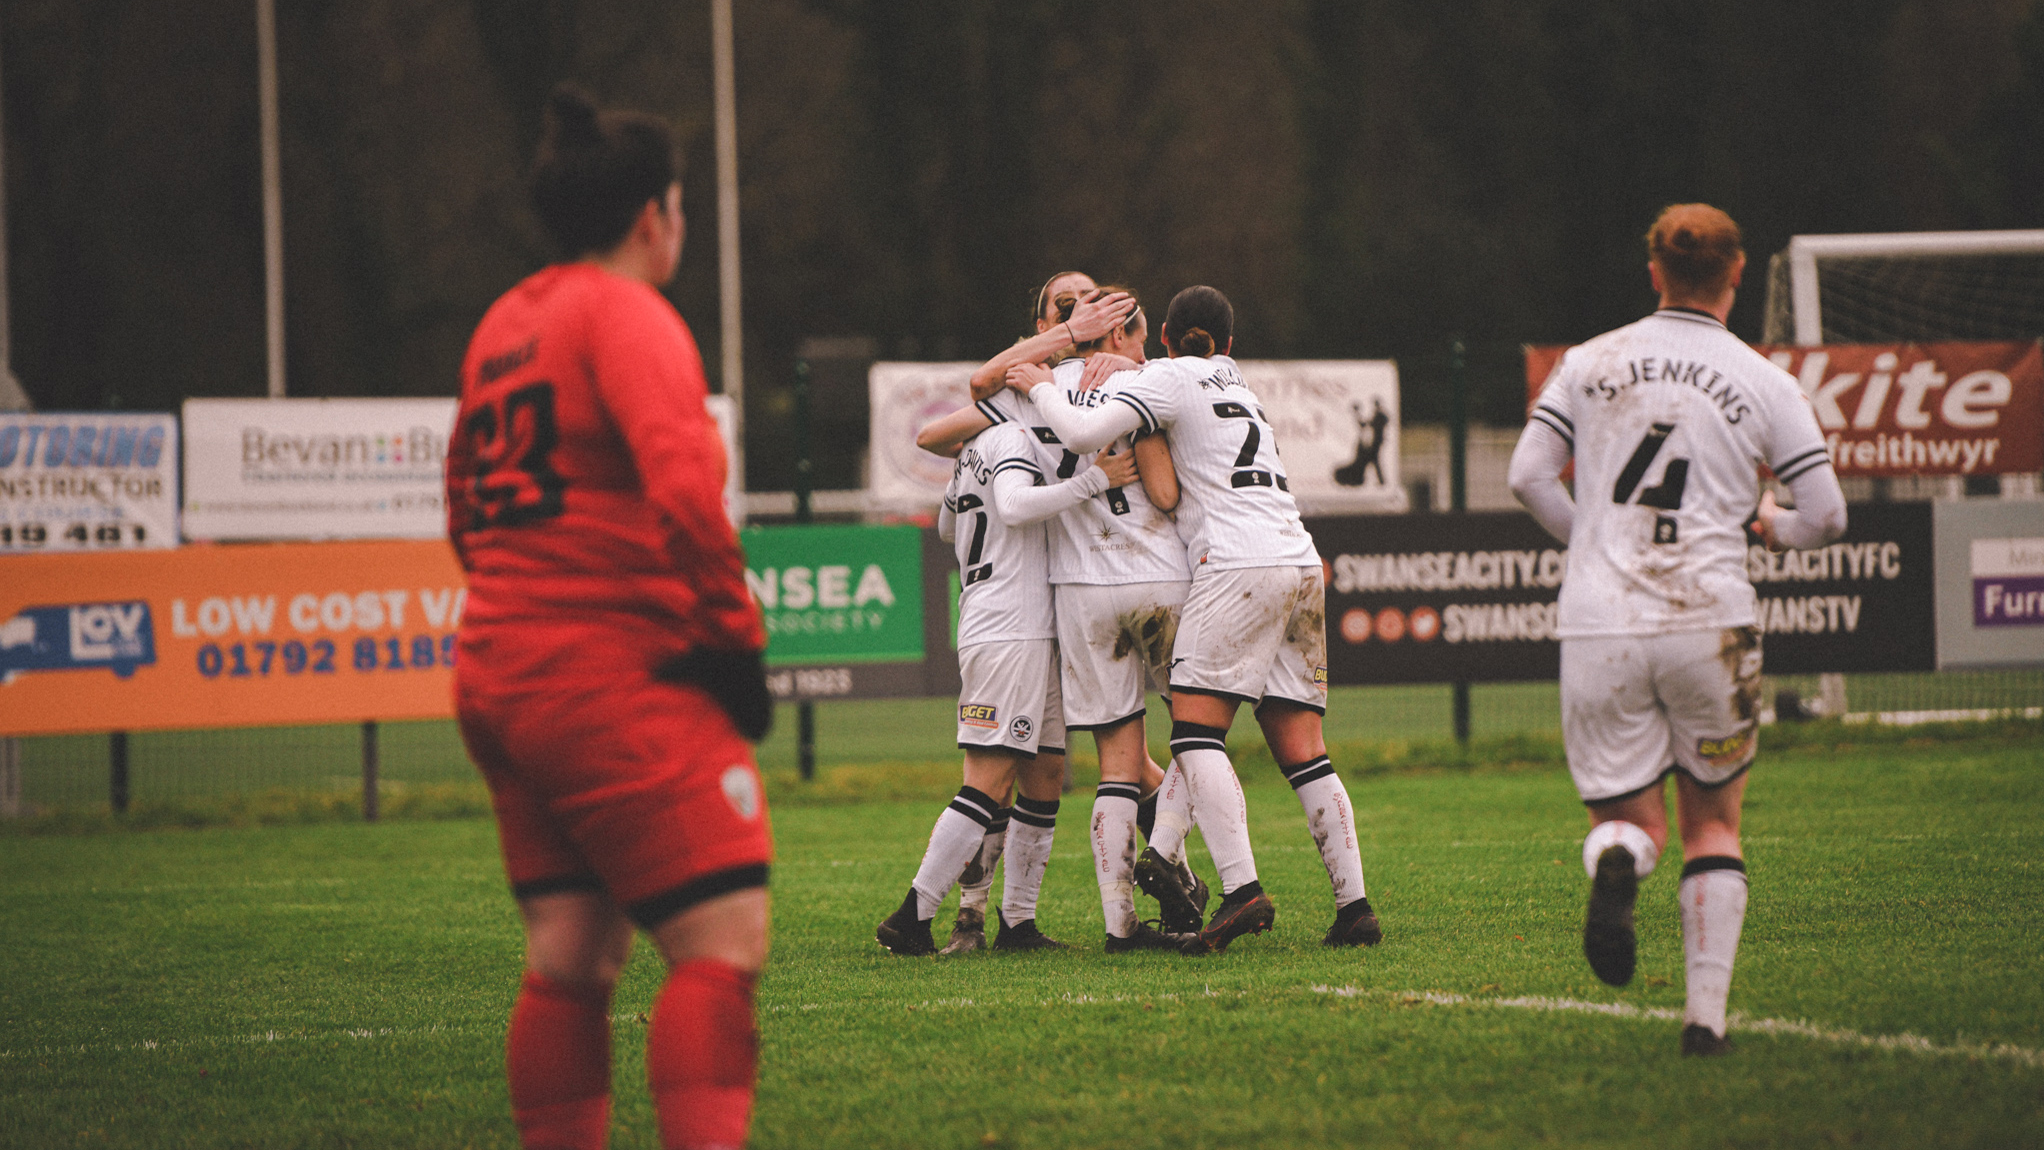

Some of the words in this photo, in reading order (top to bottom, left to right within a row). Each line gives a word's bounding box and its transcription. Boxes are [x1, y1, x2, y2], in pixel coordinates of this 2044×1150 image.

[1598, 357, 1752, 426] S.JENKINS
[241, 427, 369, 467] Bevan
[1611, 422, 1691, 544] 4
[1333, 548, 1568, 593] SWANSEACITY.C
[1747, 541, 1901, 582] SEACITYFC
[171, 595, 277, 638] LOW
[288, 588, 410, 634] COST
[196, 638, 340, 679] 01792
